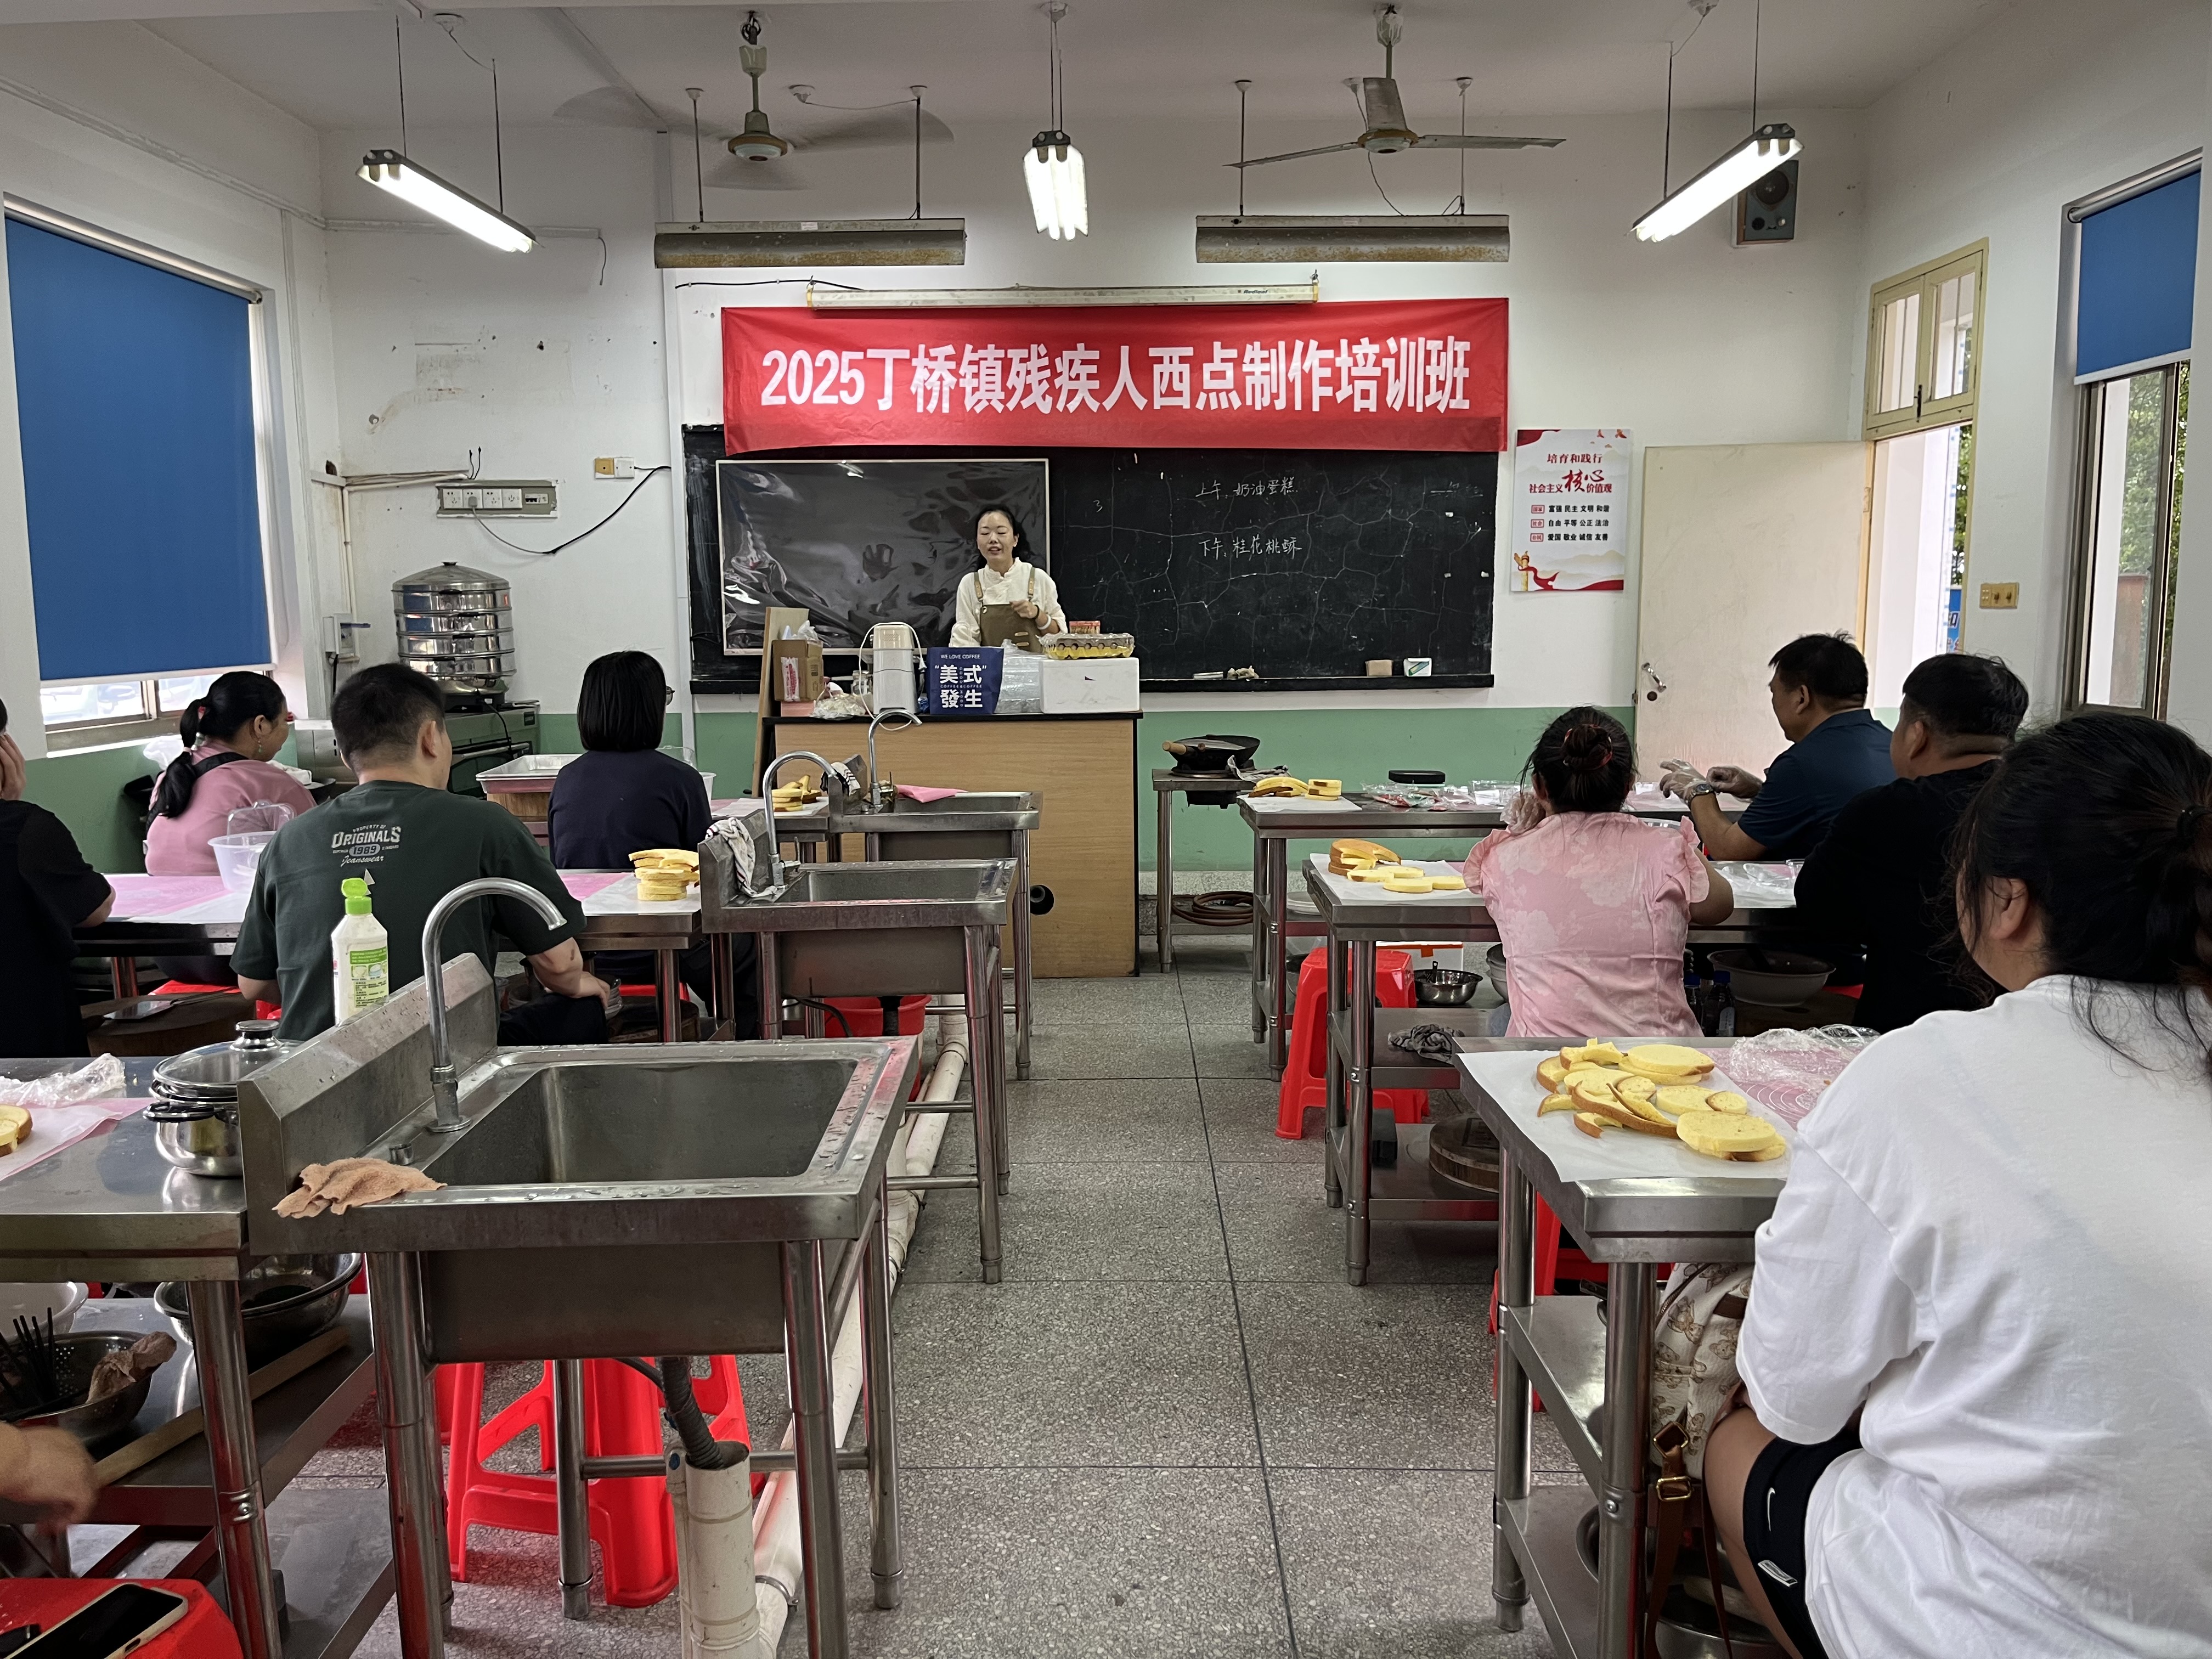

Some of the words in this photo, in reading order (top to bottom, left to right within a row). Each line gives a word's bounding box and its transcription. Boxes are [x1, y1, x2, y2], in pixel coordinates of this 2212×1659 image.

[761, 336, 1471, 414] 2025丁桥镇残疾人西点制作培训班
[1547, 453, 1602, 464] 培育和践行
[940, 689, 983, 708] 發生
[352, 825, 380, 833] PROPERTY
[331, 826, 402, 849] ORIGINALS
[353, 845, 377, 855] 1989
[340, 855, 384, 867] Jeanswear
